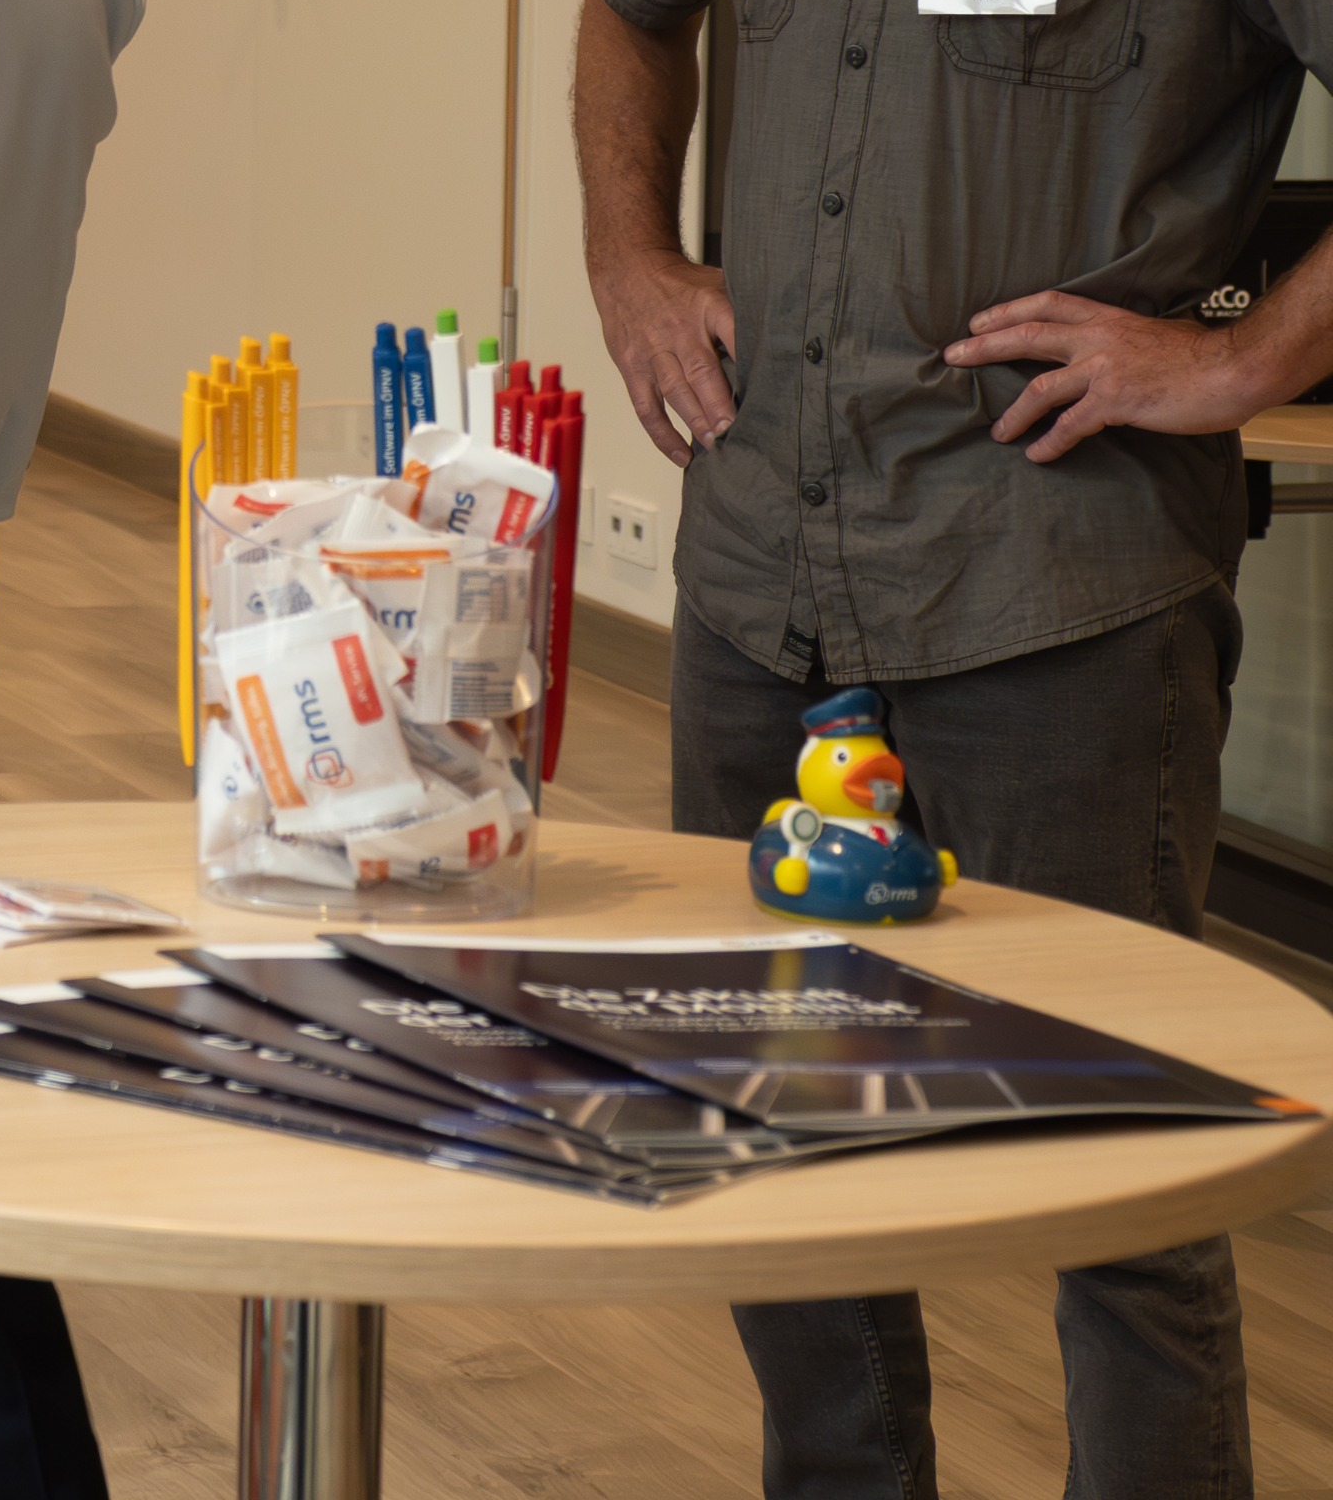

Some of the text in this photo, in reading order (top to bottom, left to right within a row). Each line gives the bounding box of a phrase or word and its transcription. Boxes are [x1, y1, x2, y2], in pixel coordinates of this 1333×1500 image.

[1201, 284, 1251, 309] tCo
[410, 371, 426, 408] ÖPNV
[380, 368, 396, 474] Software im ÖPNV
[446, 490, 476, 534] ms
[294, 679, 331, 745] rms
